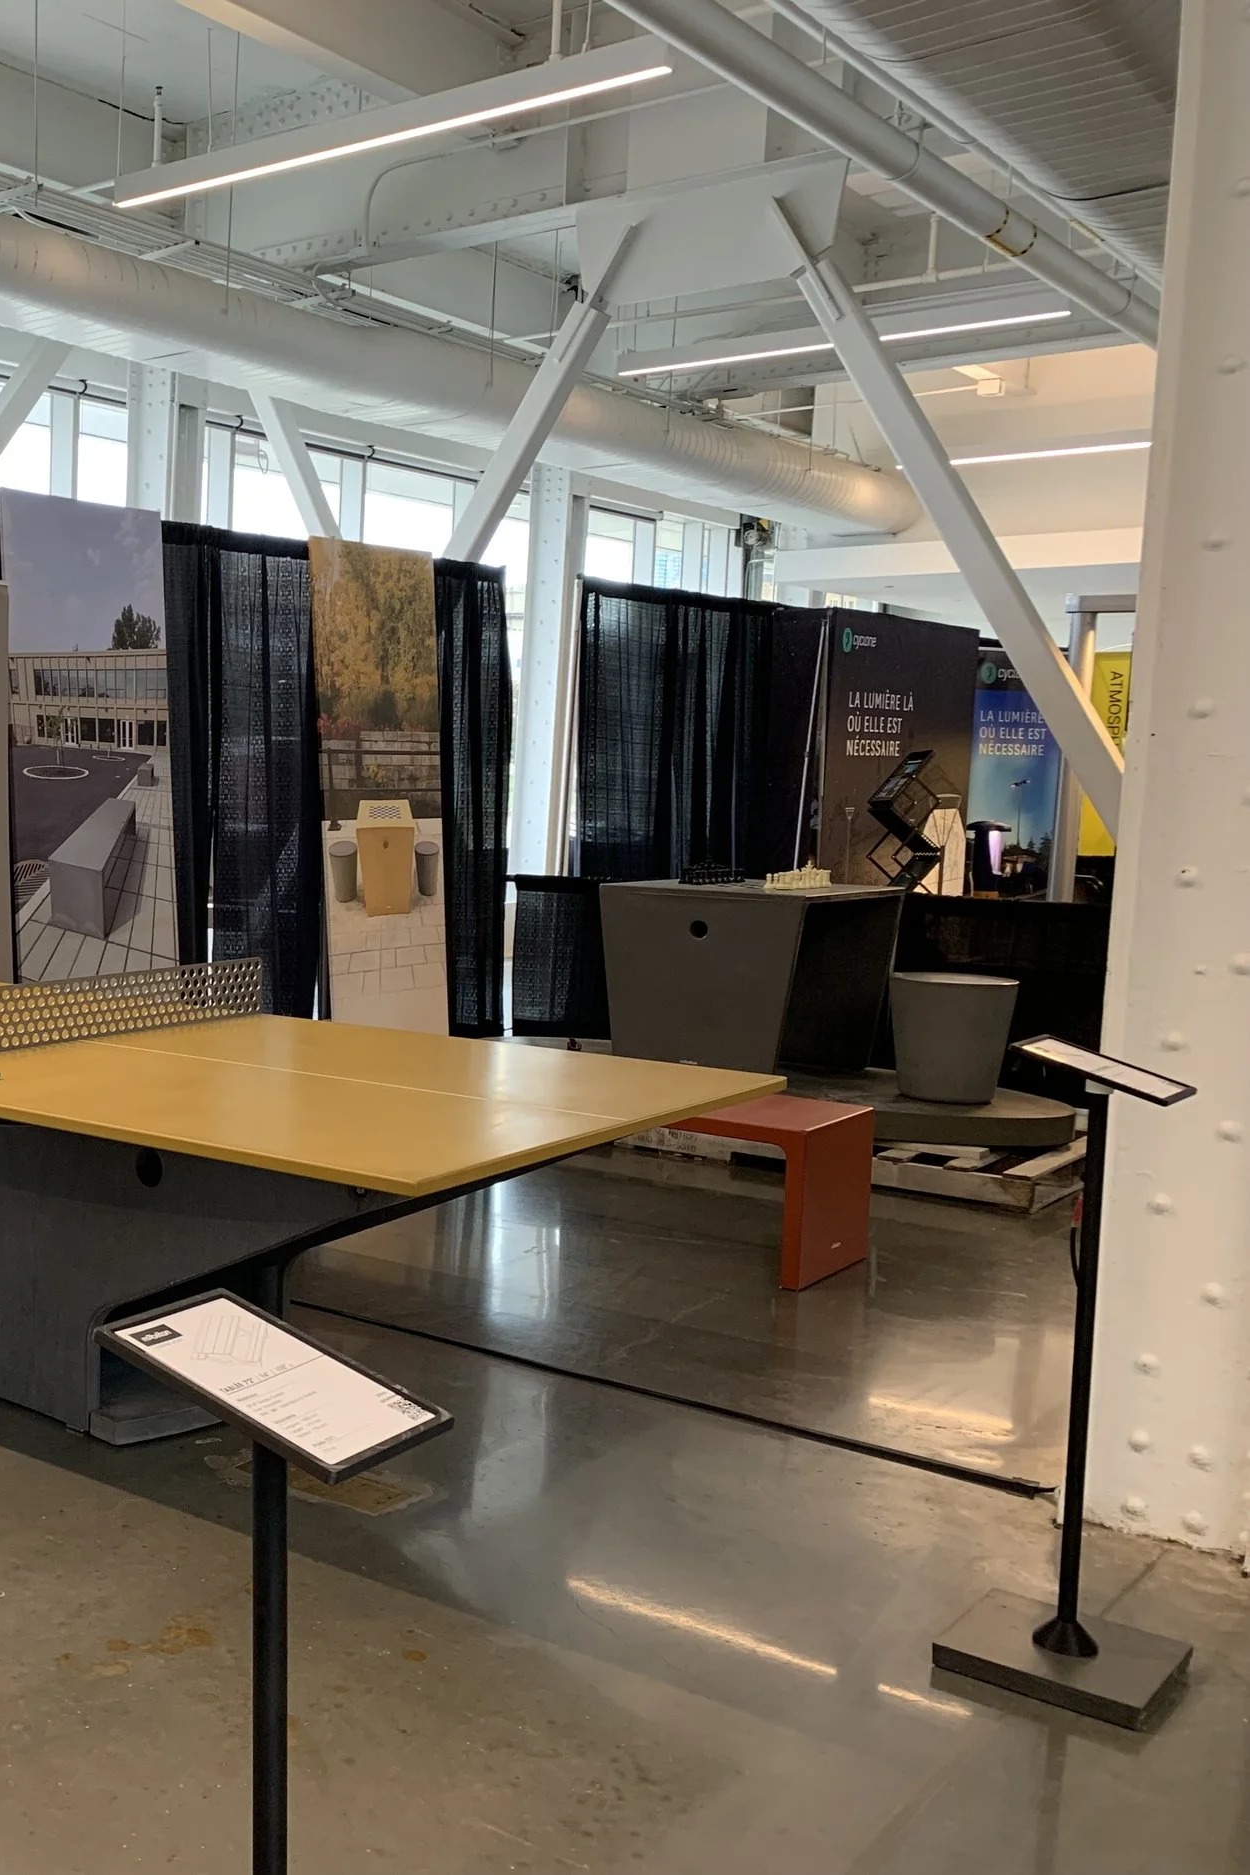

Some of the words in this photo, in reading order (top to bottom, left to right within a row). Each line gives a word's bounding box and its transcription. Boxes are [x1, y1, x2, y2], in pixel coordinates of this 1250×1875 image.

[849, 691, 861, 708] LA
[863, 689, 901, 711] LUMIÈRE
[903, 691, 914, 711] LÀ
[847, 711, 861, 732] OÙ
[864, 716, 885, 733] ELLE
[887, 717, 902, 734] EST
[980, 710, 994, 722] LA
[998, 709, 1044, 724] LUMIÈRE
[979, 724, 996, 739] OÙ
[999, 727, 1025, 740] ELLE
[1028, 728, 1047, 740] EST
[846, 735, 900, 757] NÉCESSAIRE
[979, 740, 1045, 756] NÉCESSAIRE
